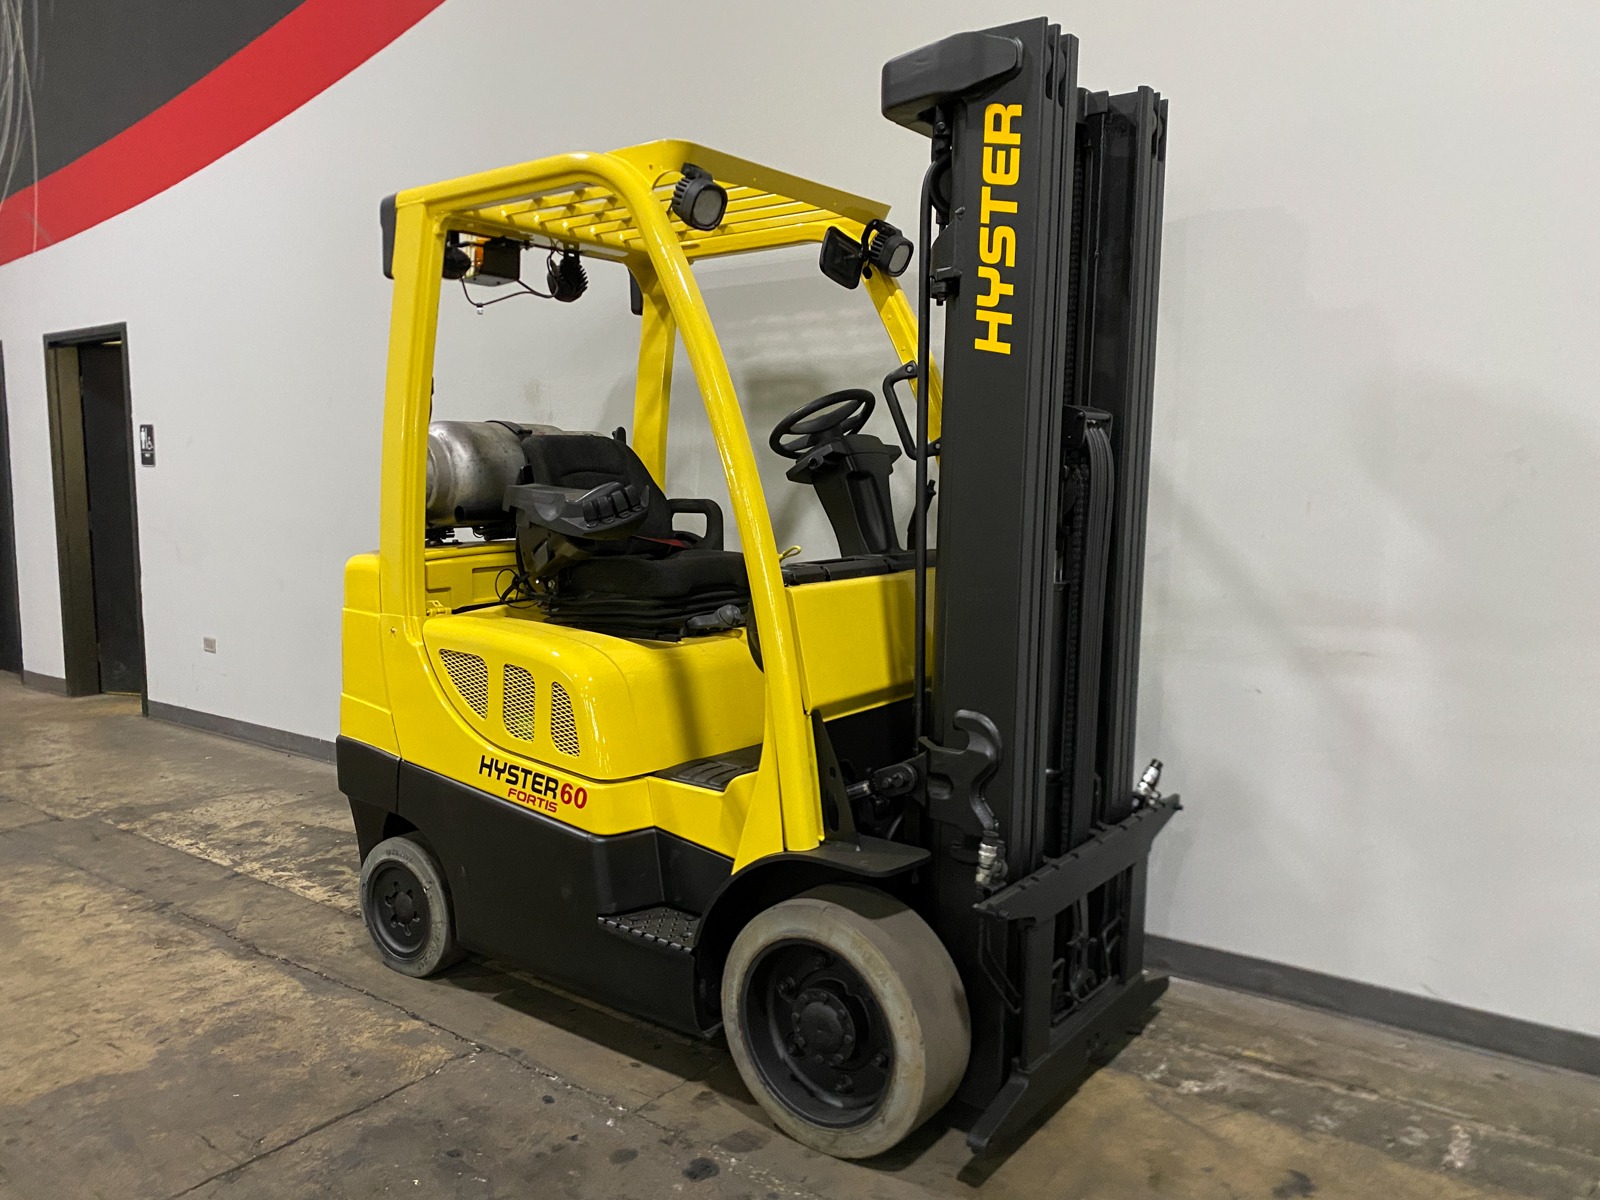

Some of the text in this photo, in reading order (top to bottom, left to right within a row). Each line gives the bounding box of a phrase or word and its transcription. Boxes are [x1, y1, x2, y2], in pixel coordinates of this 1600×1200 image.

[974, 103, 1023, 355] HYSTER
[479, 755, 588, 809] HYSTER 60
[507, 787, 558, 813] FORTIS
